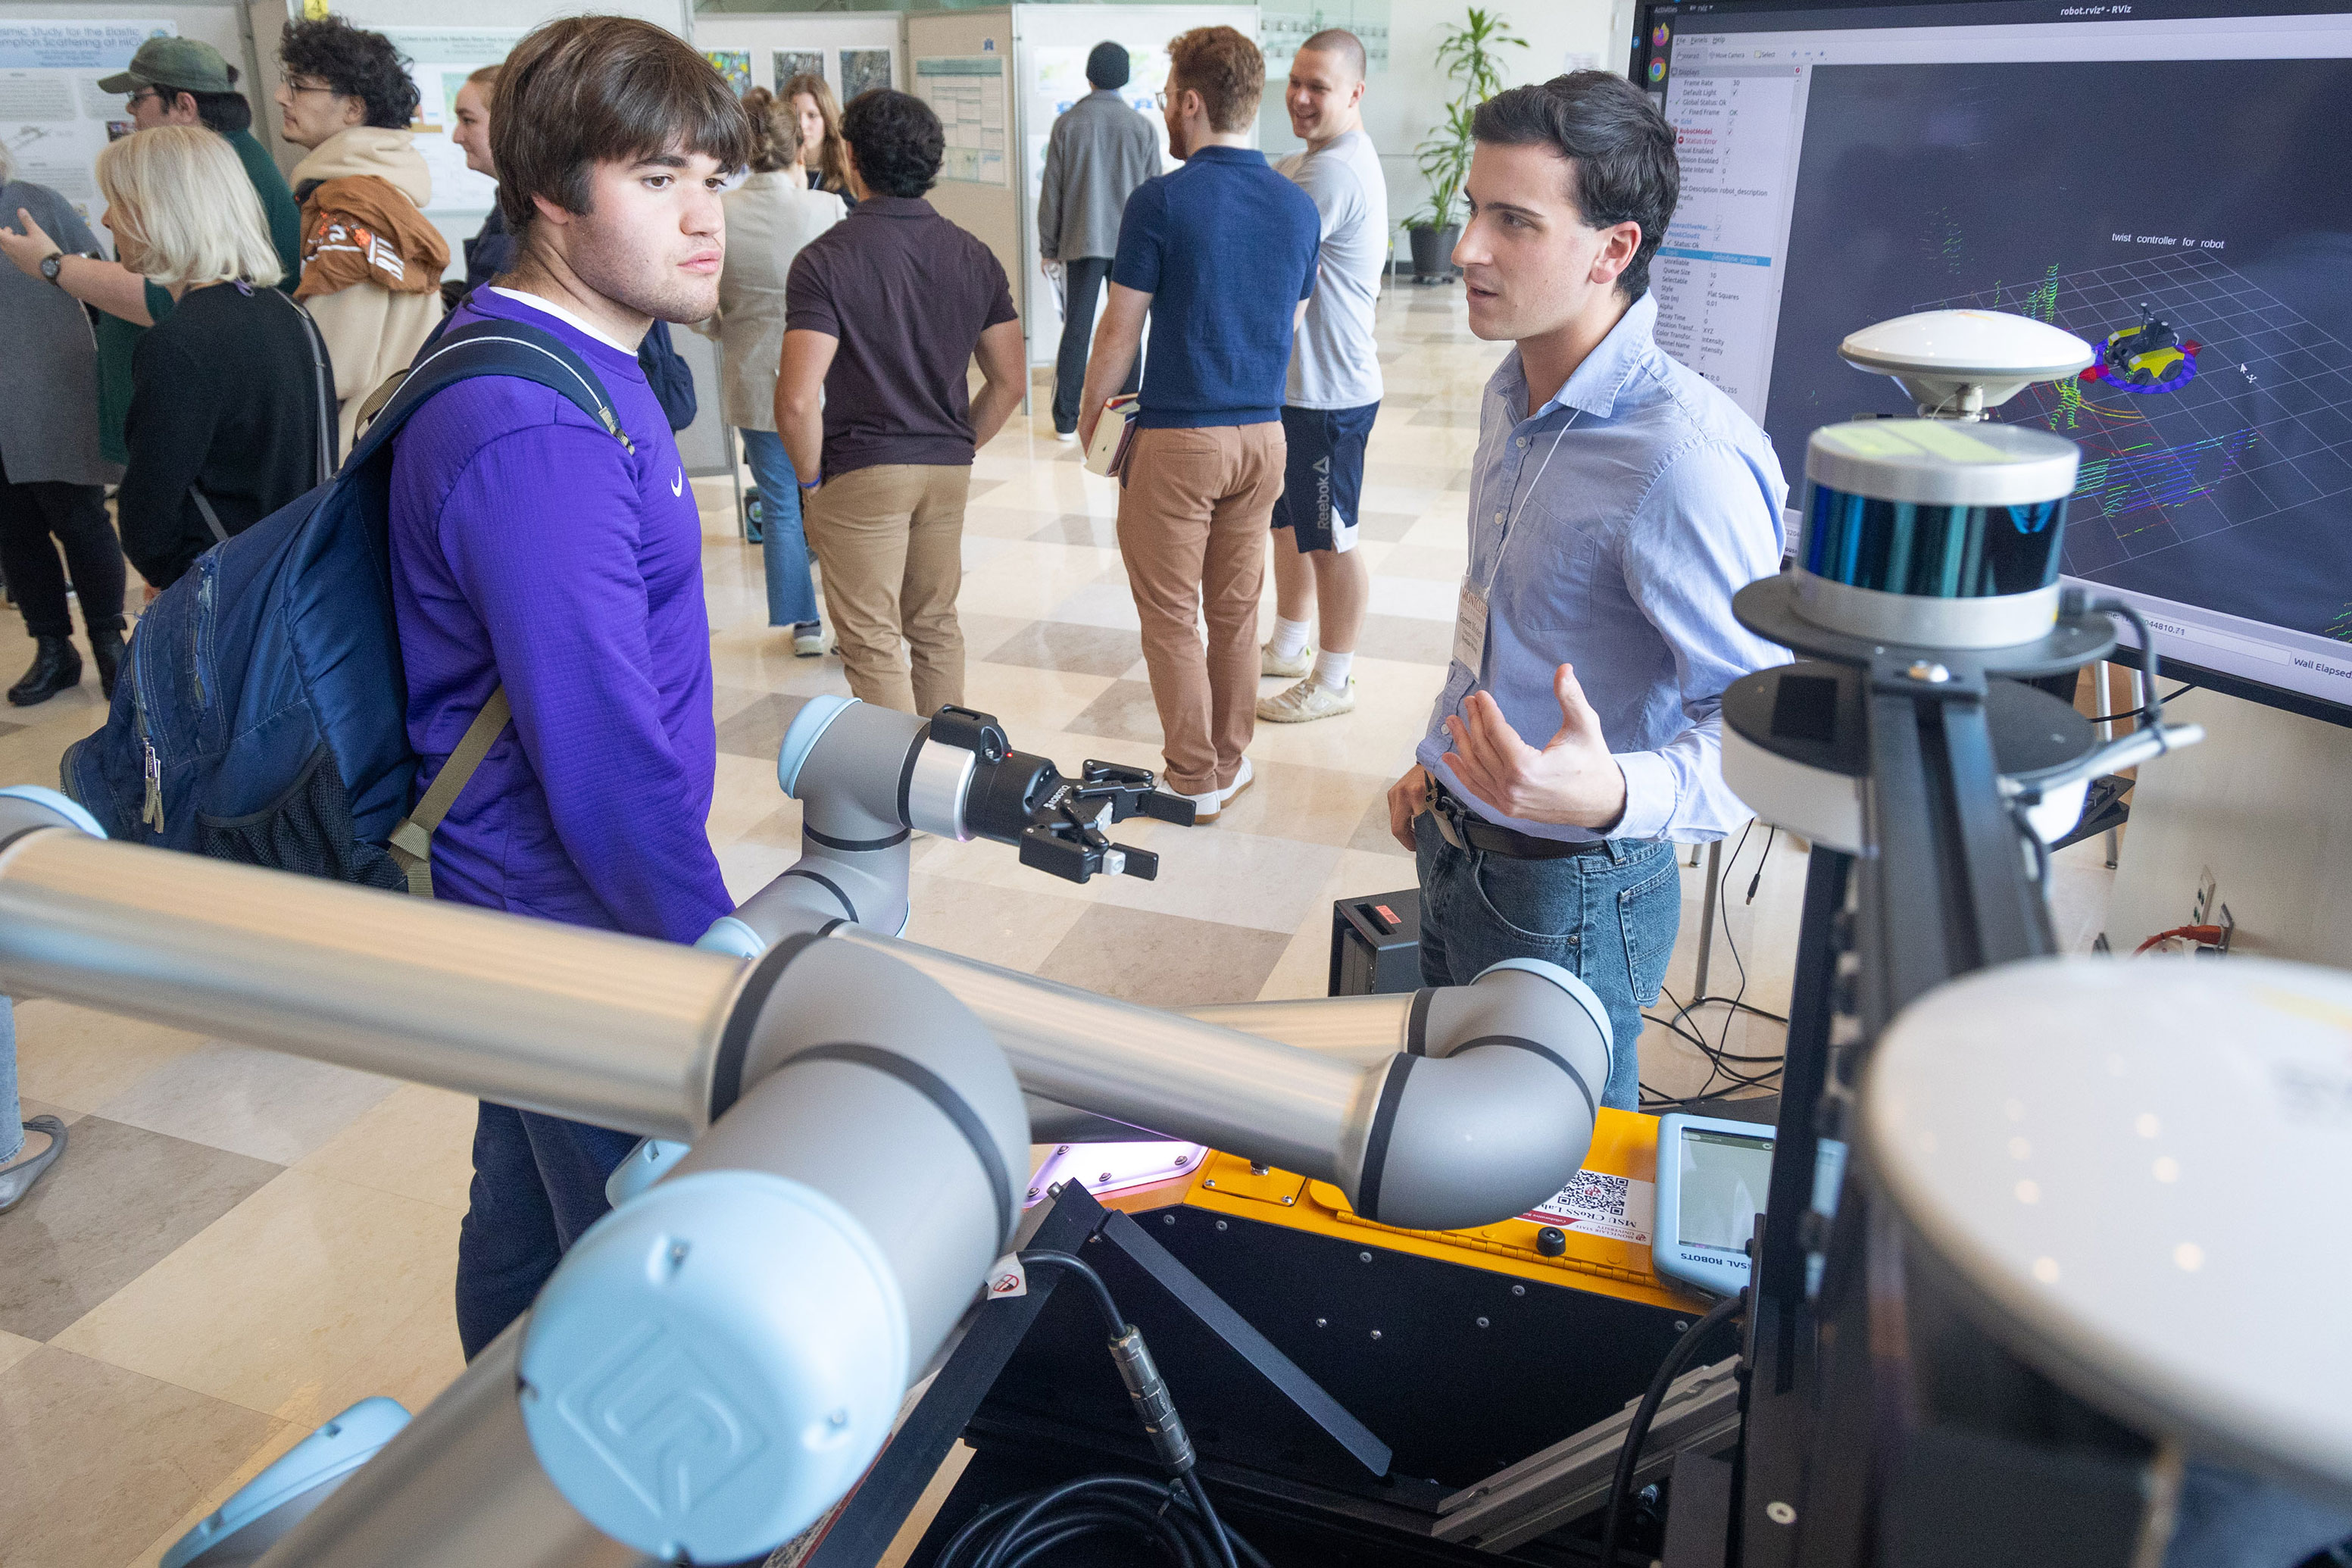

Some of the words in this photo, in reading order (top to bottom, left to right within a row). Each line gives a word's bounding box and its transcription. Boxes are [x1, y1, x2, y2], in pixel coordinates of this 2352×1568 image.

[2112, 5, 2132, 14] RViz
[2112, 233, 2132, 242] twist
[2137, 235, 2177, 245] controller
[2182, 237, 2195, 247] for
[2201, 239, 2225, 249] robot
[1662, 276, 1688, 285] Selectable
[1718, 292, 1739, 301] Squares
[1317, 475, 1329, 530] Reebok
[2294, 657, 2314, 669] Wall
[1566, 1209, 1605, 1221] CRoSS
[1608, 1217, 1637, 1228] MSU
[1595, 1228, 1634, 1240] MONTCLAIR
[1597, 1225, 1635, 1236] UNIVERSITY
[1680, 1253, 1723, 1265] ROBOTS
